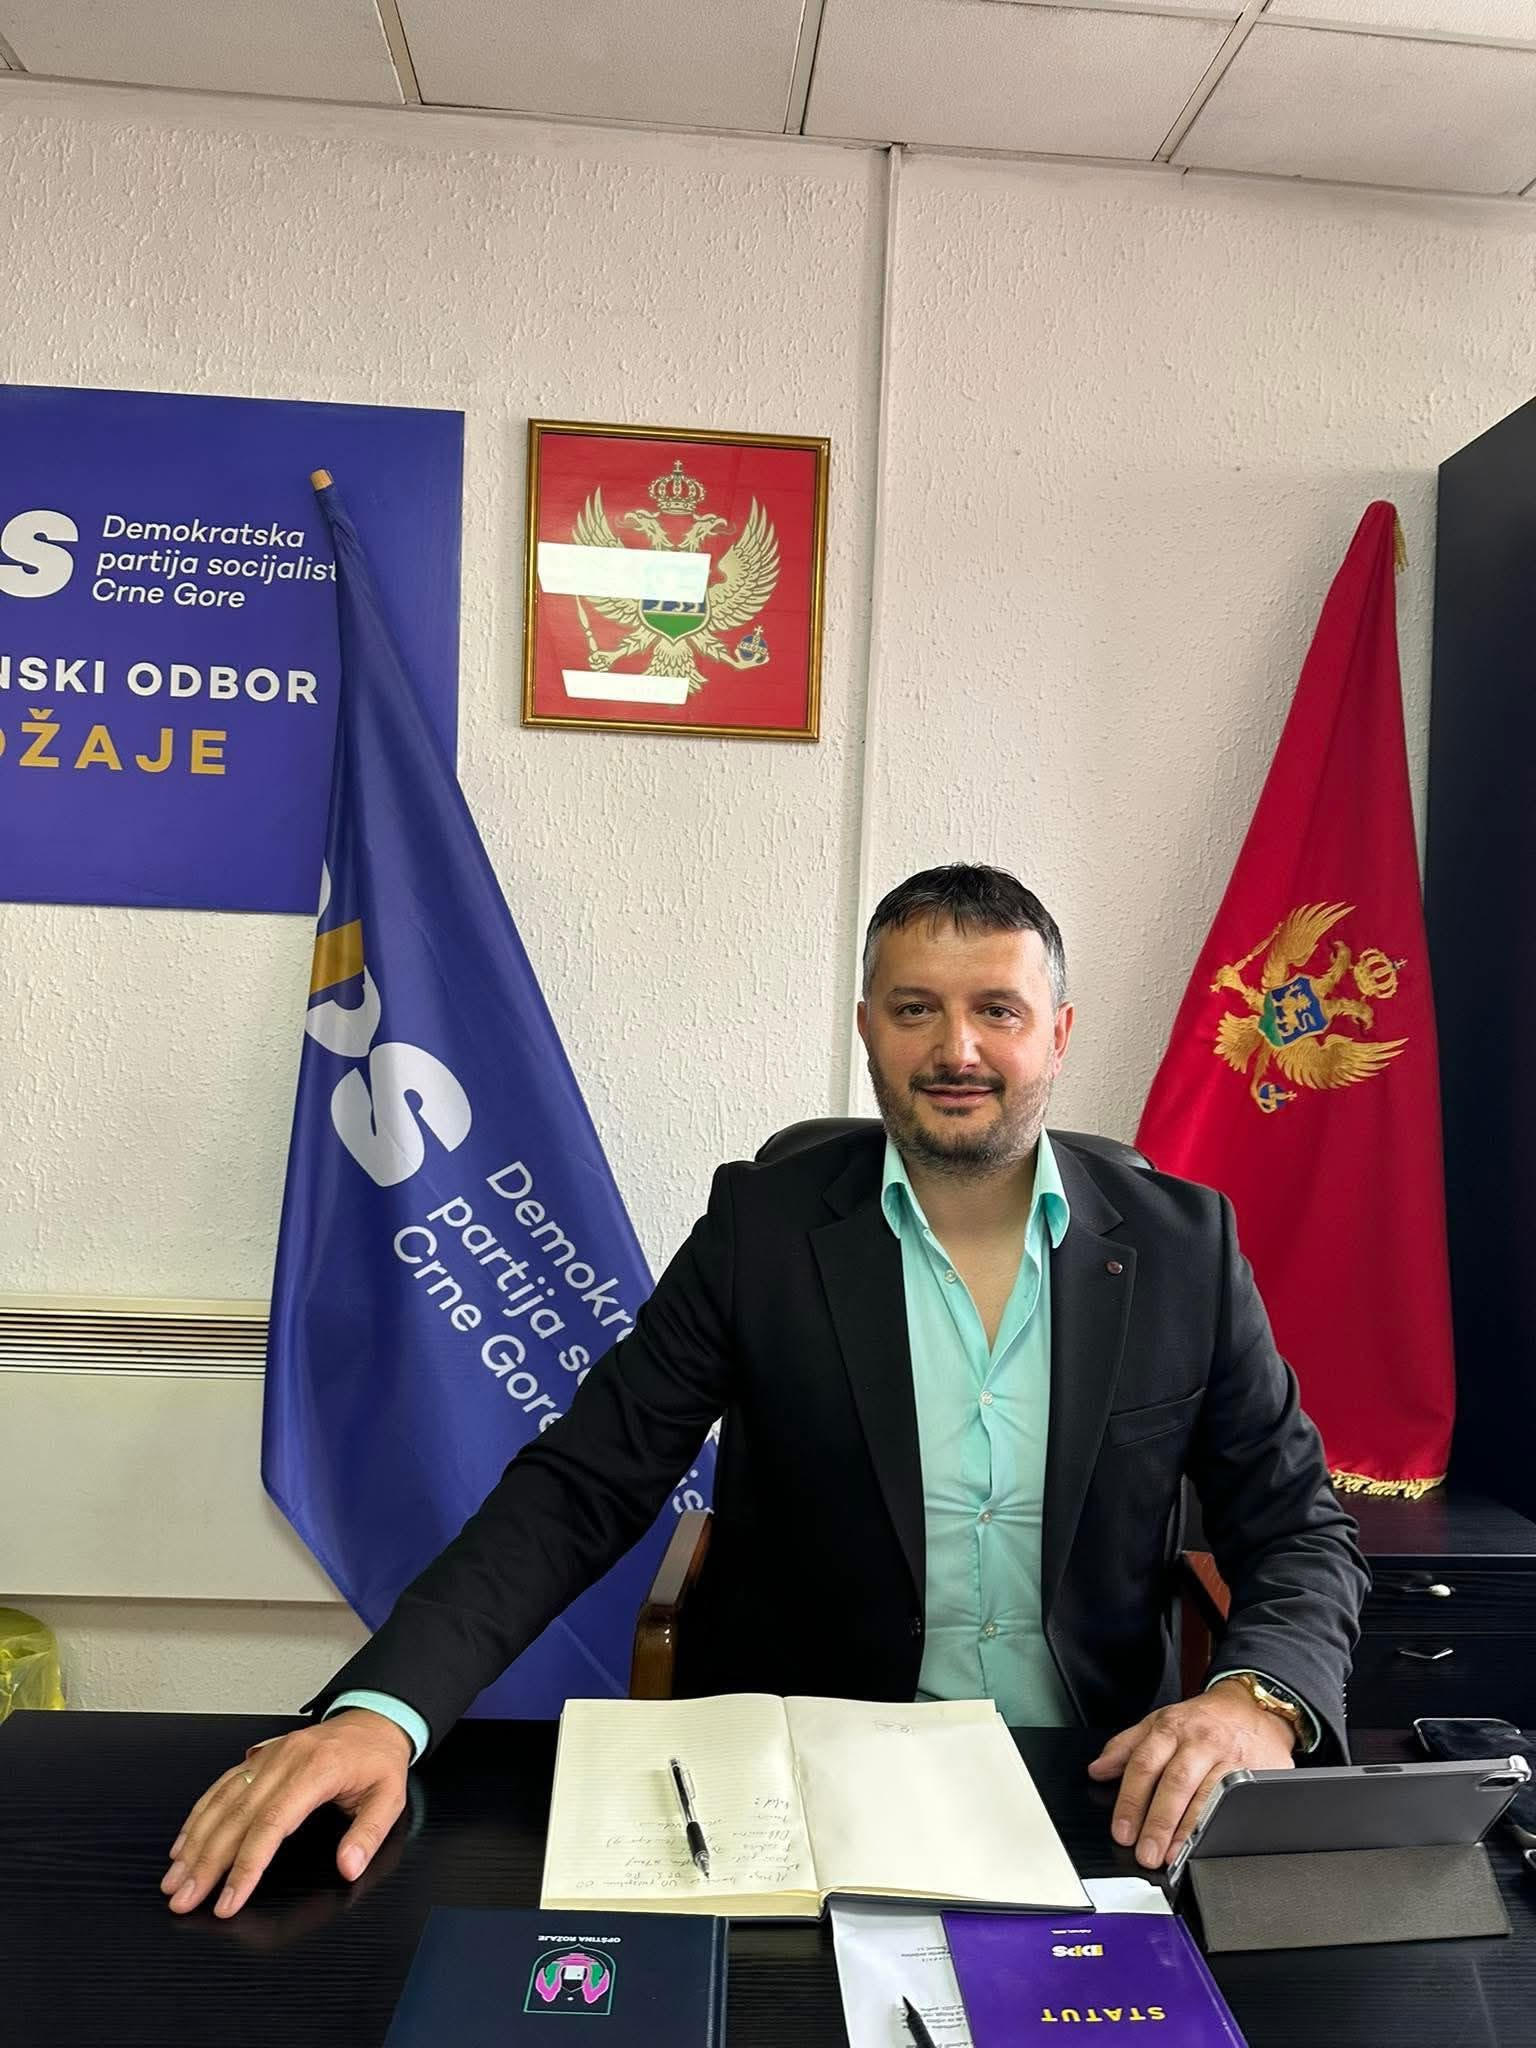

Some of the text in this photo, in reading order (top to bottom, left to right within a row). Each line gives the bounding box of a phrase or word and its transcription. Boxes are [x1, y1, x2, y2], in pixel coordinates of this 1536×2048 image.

[102, 514, 305, 548] Demokratska
[96, 549, 199, 580] partija
[92, 578, 246, 608] Crne Gore
[127, 661, 319, 704] ODBOR
[0, 707, 228, 775] ŽAJE
[393, 1225, 482, 1331] Crne
[426, 1196, 566, 1340] partija
[1051, 1944, 1104, 1957] DPS
[1041, 2006, 1166, 2022] STATUT
